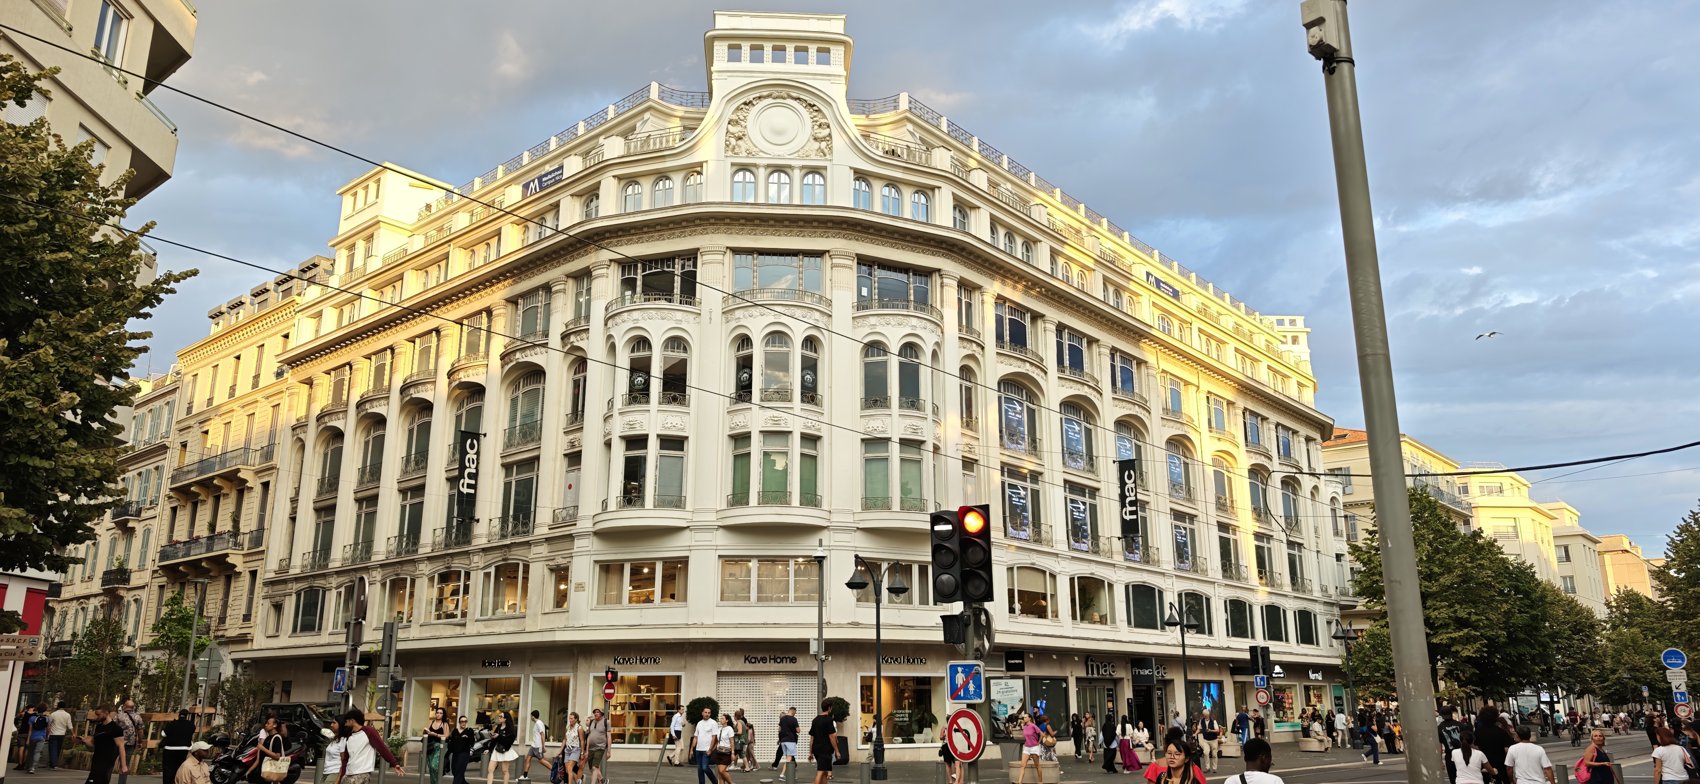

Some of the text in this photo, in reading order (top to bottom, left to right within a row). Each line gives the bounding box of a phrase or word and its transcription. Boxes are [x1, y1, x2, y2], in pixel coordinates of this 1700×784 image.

[459, 438, 478, 494] fnac
[1122, 469, 1137, 520] fnac
[613, 656, 661, 665] Kave Home
[743, 654, 798, 664] Kave Home
[881, 655, 927, 664] Kave Home
[1087, 656, 1117, 677] fnac
[1132, 667, 1153, 676] fnac
